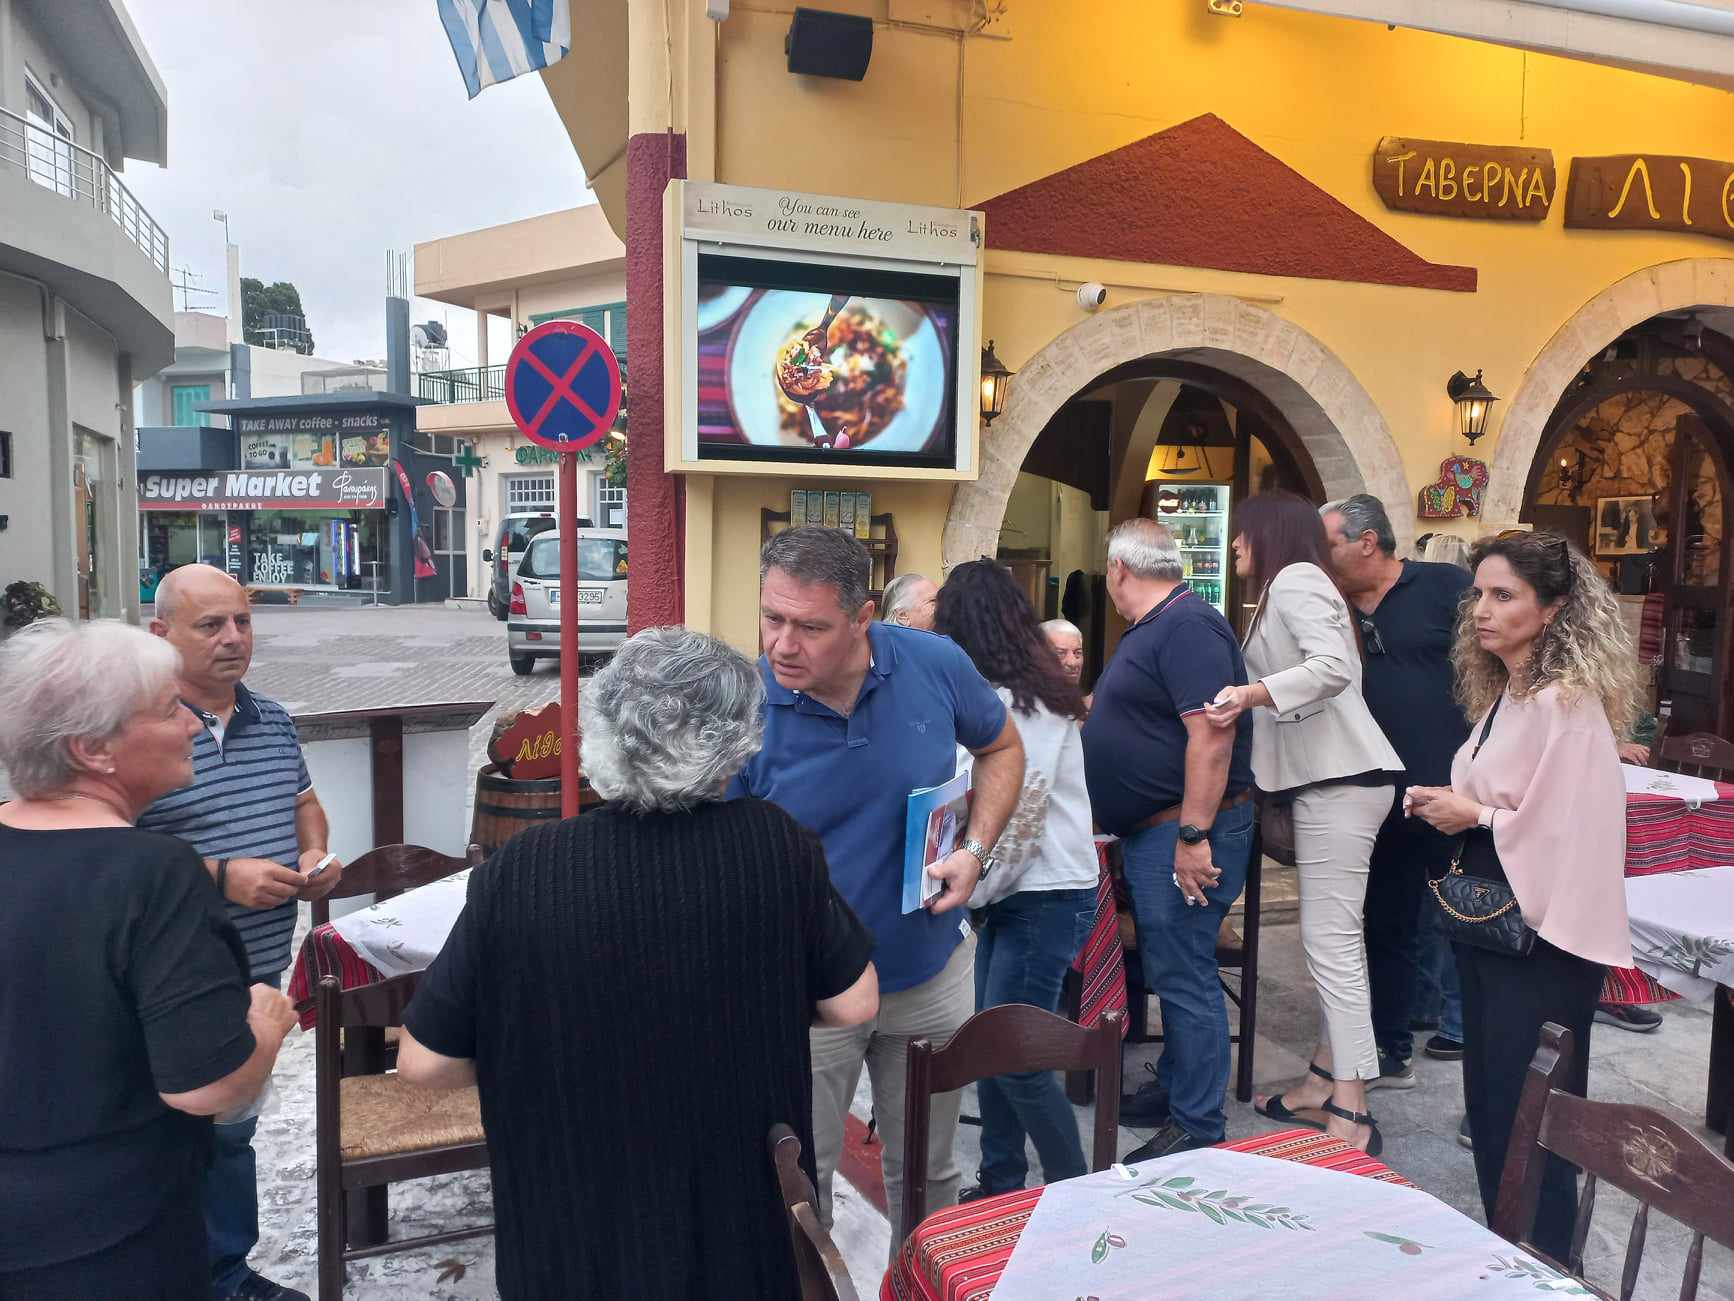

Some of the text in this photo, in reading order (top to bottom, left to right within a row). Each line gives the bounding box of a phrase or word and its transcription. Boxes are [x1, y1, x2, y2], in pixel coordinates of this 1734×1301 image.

[697, 199, 753, 219] Lithos
[778, 196, 861, 219] You can see
[767, 218, 894, 242] our menu here
[907, 219, 957, 238] Lithos
[241, 418, 266, 432] TAKE
[268, 417, 297, 431] AWAY
[299, 416, 332, 430] coffee
[342, 415, 378, 428] snacks
[145, 475, 219, 501] Super
[225, 472, 322, 498] Market
[253, 552, 283, 564] TAKE
[254, 561, 294, 574] COFFEE
[253, 571, 287, 583] ENJOY
